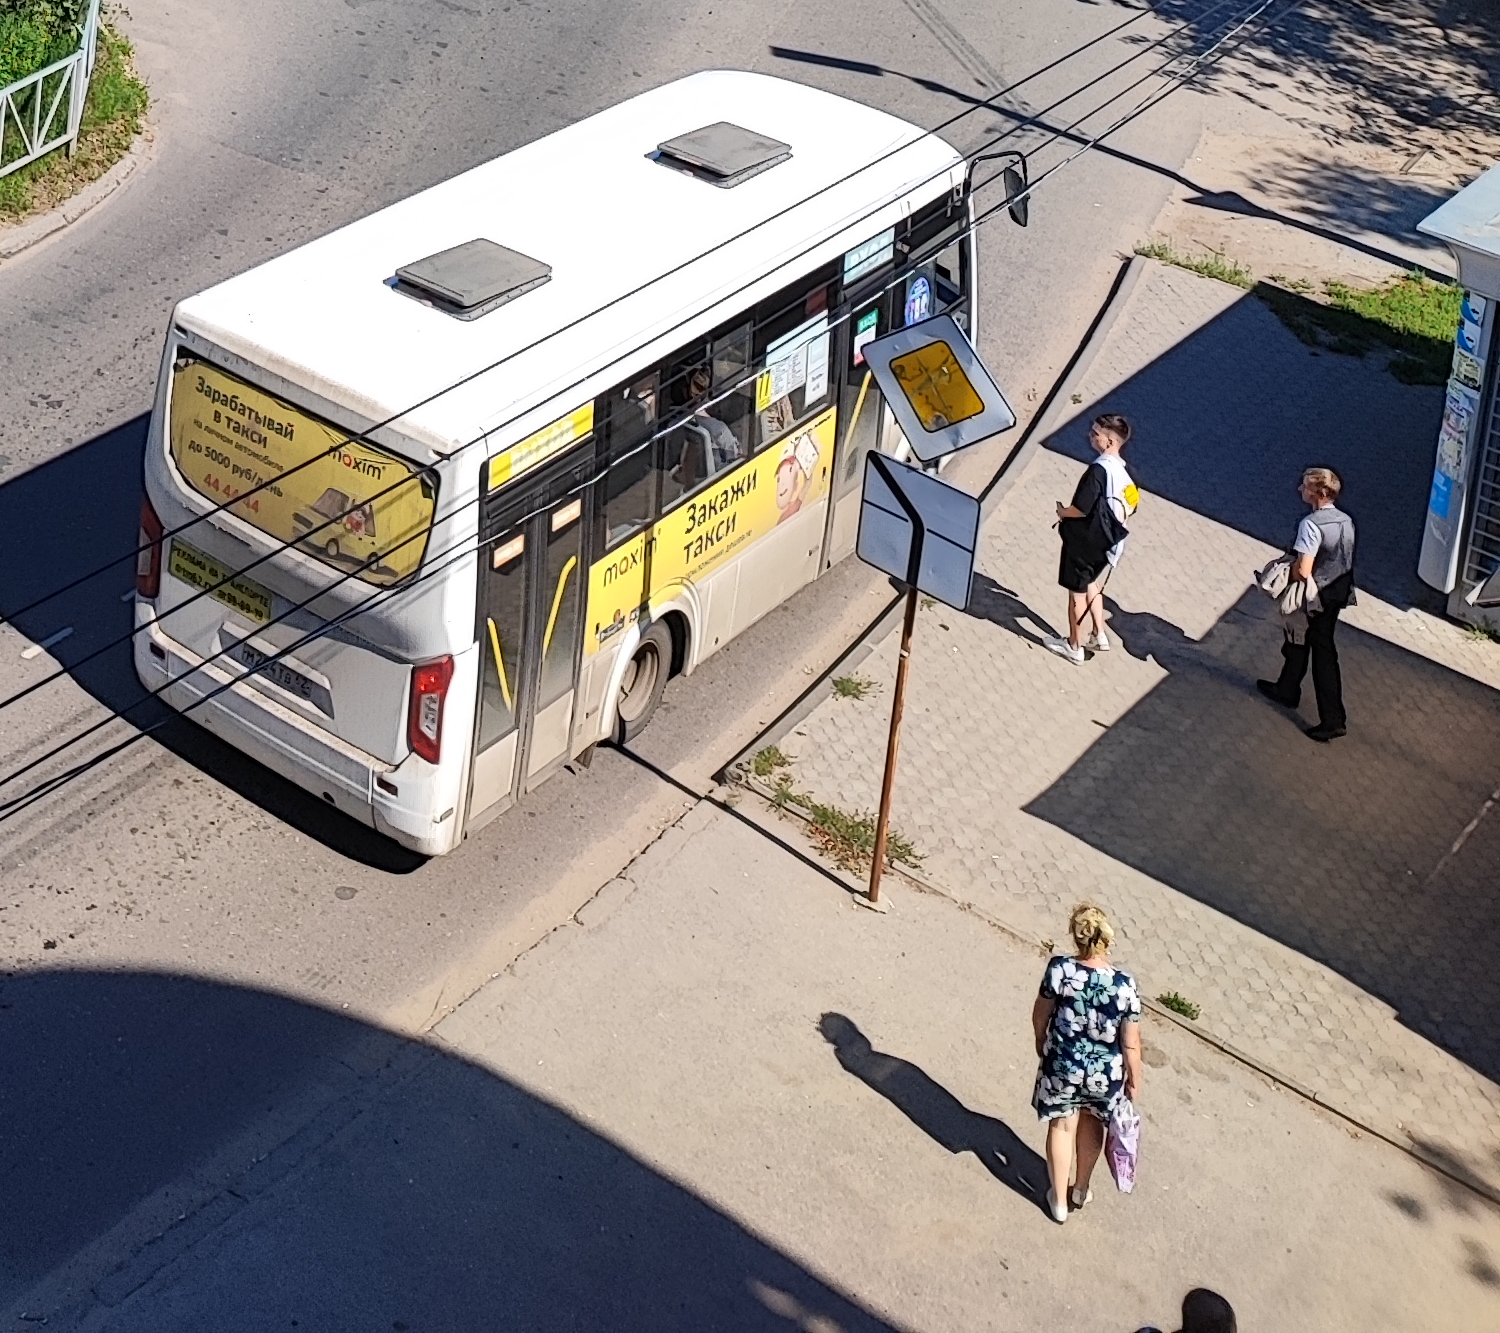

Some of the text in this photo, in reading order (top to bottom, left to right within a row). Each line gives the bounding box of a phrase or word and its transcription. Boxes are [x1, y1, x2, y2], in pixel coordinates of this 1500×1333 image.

[195, 375, 295, 441] Зарабатывай
[213, 409, 268, 449] в такси
[188, 440, 202, 454] до
[204, 446, 230, 468] 5000
[203, 473, 219, 492] 44
[685, 468, 757, 535] Закажи
[684, 511, 737, 564] такси
